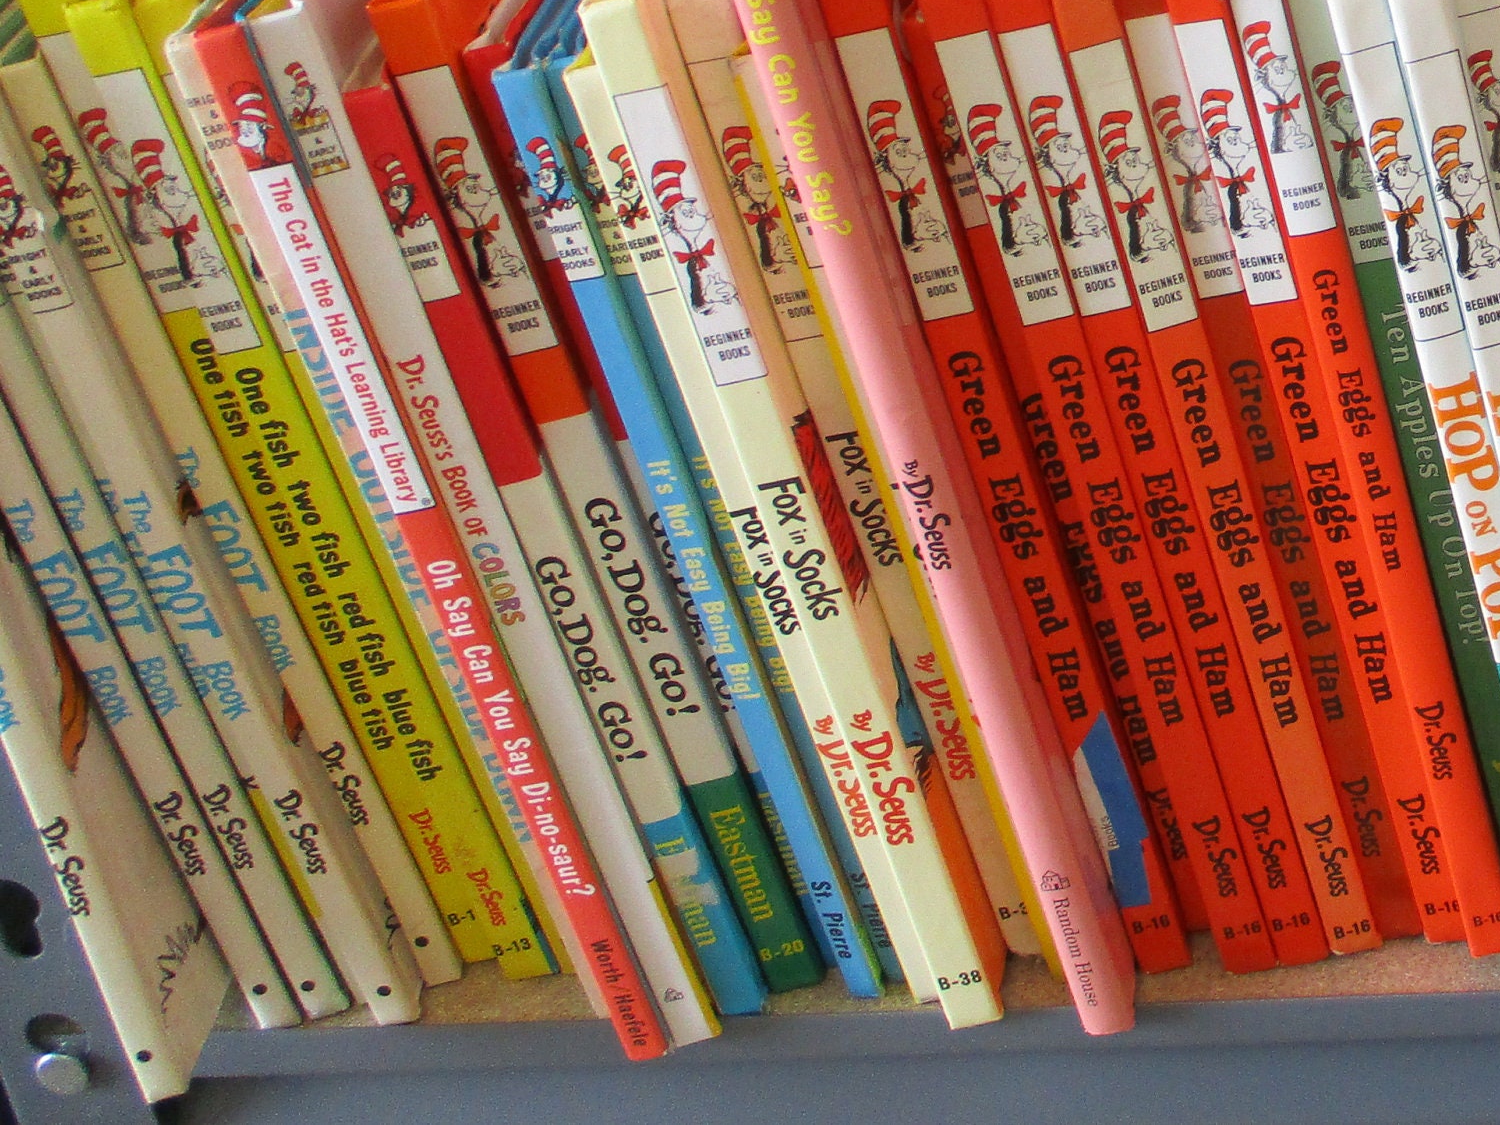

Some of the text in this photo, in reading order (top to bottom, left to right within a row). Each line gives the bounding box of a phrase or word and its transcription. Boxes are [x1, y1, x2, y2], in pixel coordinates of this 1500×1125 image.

[767, 53, 799, 105] Can
[787, 111, 817, 164] You
[805, 171, 853, 237] Say?
[547, 221, 596, 271] BRIGHT & EARLY BOOKS
[1012, 268, 1061, 289] BEGINNER
[1026, 286, 1059, 302] BOOKS
[267, 177, 418, 505] The Cat in the Hat's Learning Library
[704, 328, 752, 347] BEGINNER
[719, 345, 751, 362] BOOKS
[1312, 268, 1402, 573] Green Eggs and Ham
[1427, 370, 1500, 492] HOP
[1465, 500, 1497, 537] ON
[396, 355, 425, 390] Dr.
[411, 394, 453, 462] Seuss's
[441, 465, 479, 514] BOOK
[471, 543, 526, 627] COLORS
[757, 475, 844, 622] Fox in Socks
[903, 474, 935, 515] Dr.
[919, 513, 952, 572] Seuss
[1104, 346, 1236, 719] Green Eggs and Ham
[6, 499, 133, 727] The FOOT BOOK
[235, 366, 444, 783] One fish two fish red fish blue fish
[584, 497, 701, 717] Go, Dog. Go!
[646, 458, 762, 700] It's Not Easy Being Big!
[427, 559, 596, 898] Oh Say Can You Say Di-no-saur?
[849, 708, 916, 846] By Dr. Seuss
[1414, 700, 1457, 781] Dr. Seuss
[709, 805, 774, 923] Eastman
[810, 880, 853, 961] St. Pierre
[1272, 913, 1311, 932] B-16
[491, 938, 533, 957] B-13
[761, 940, 804, 962] B-20
[938, 969, 982, 991] B-38
[1052, 897, 1098, 1008] Random House
